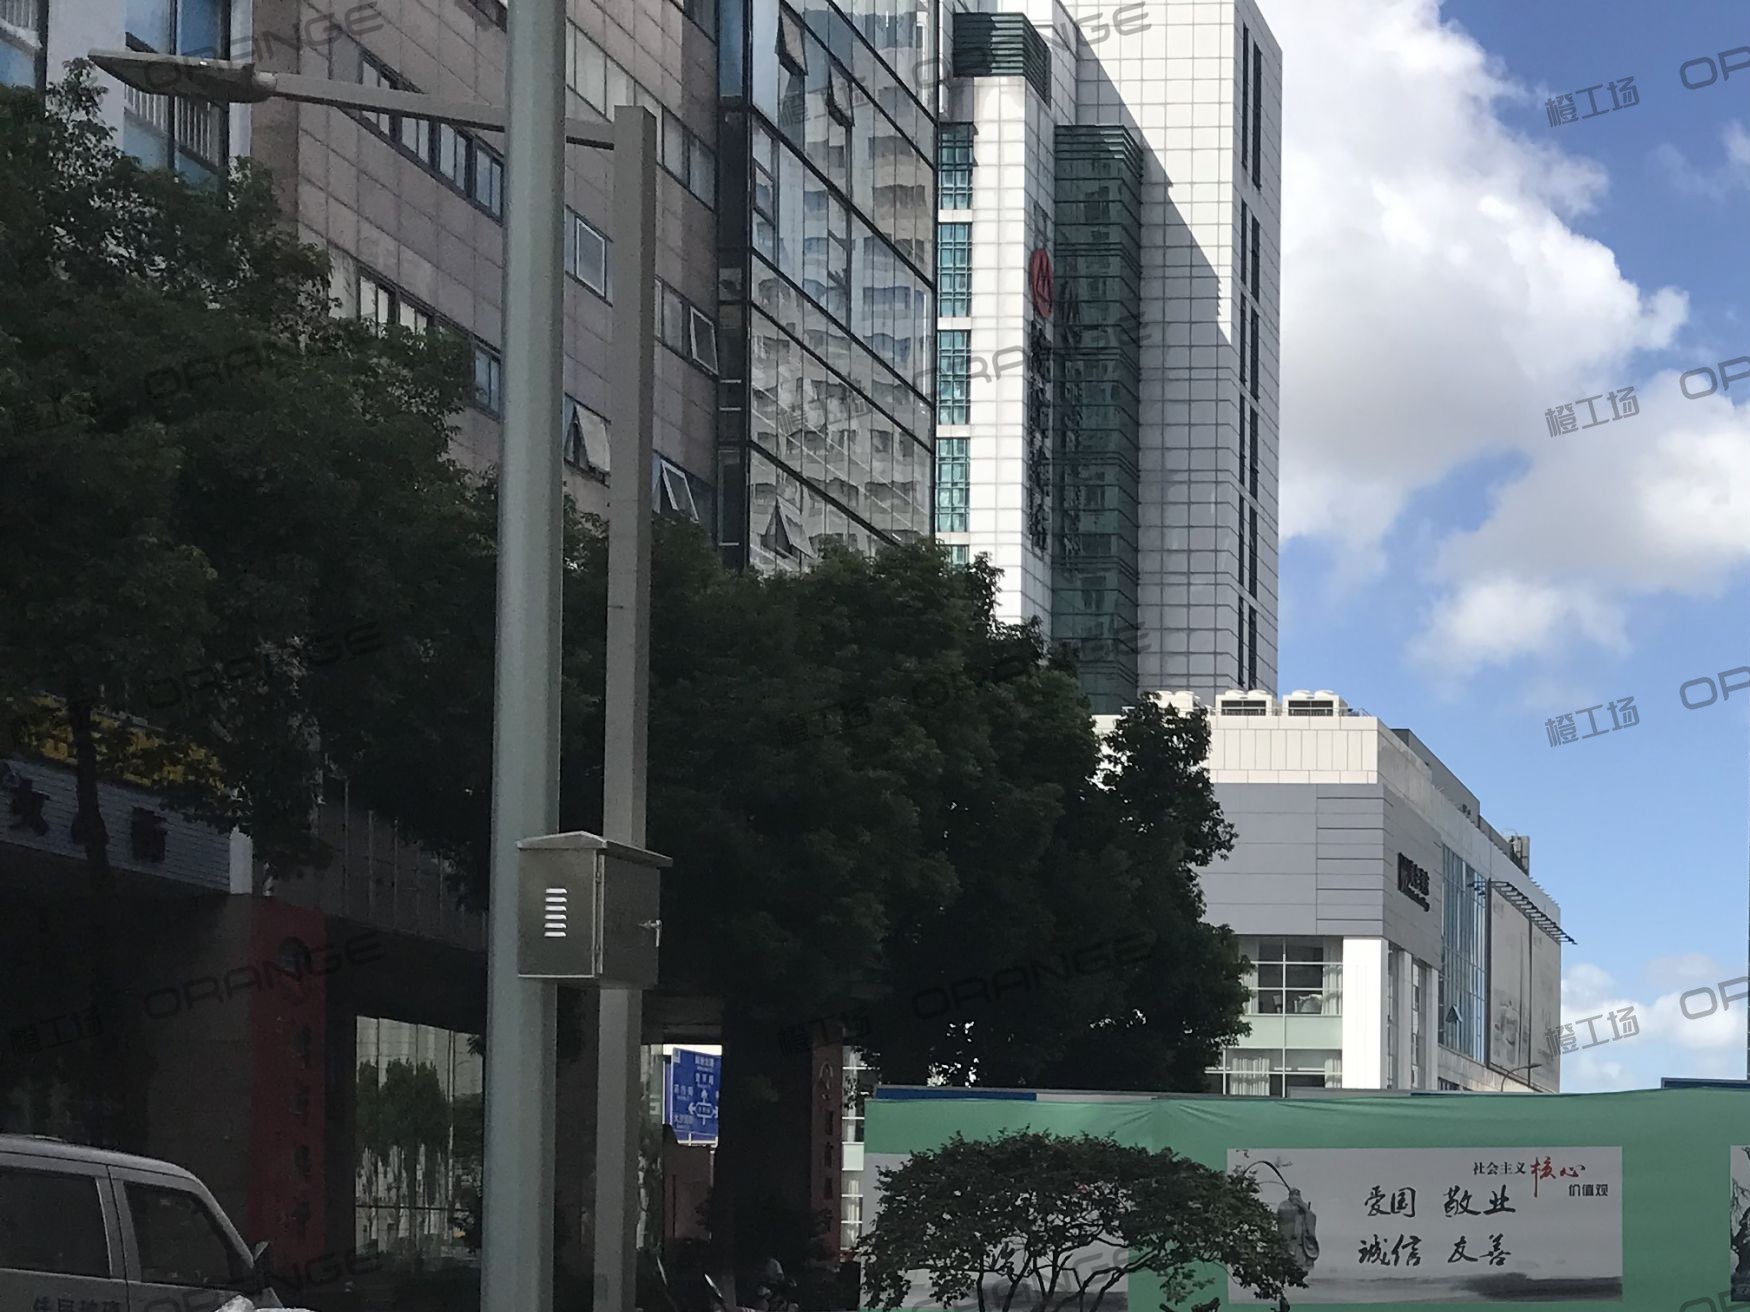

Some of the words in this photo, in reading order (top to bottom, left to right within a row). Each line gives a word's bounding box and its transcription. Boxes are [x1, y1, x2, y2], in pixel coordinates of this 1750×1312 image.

[1473, 1160, 1527, 1176] 社会主义
[1530, 1155, 1586, 1198] 核心
[1568, 1183, 1609, 1197] 价值观
[1364, 1185, 1417, 1218] 爱国
[1443, 1184, 1516, 1218] 敬业
[1358, 1234, 1422, 1267] 诚信
[1447, 1233, 1512, 1266] 友善
